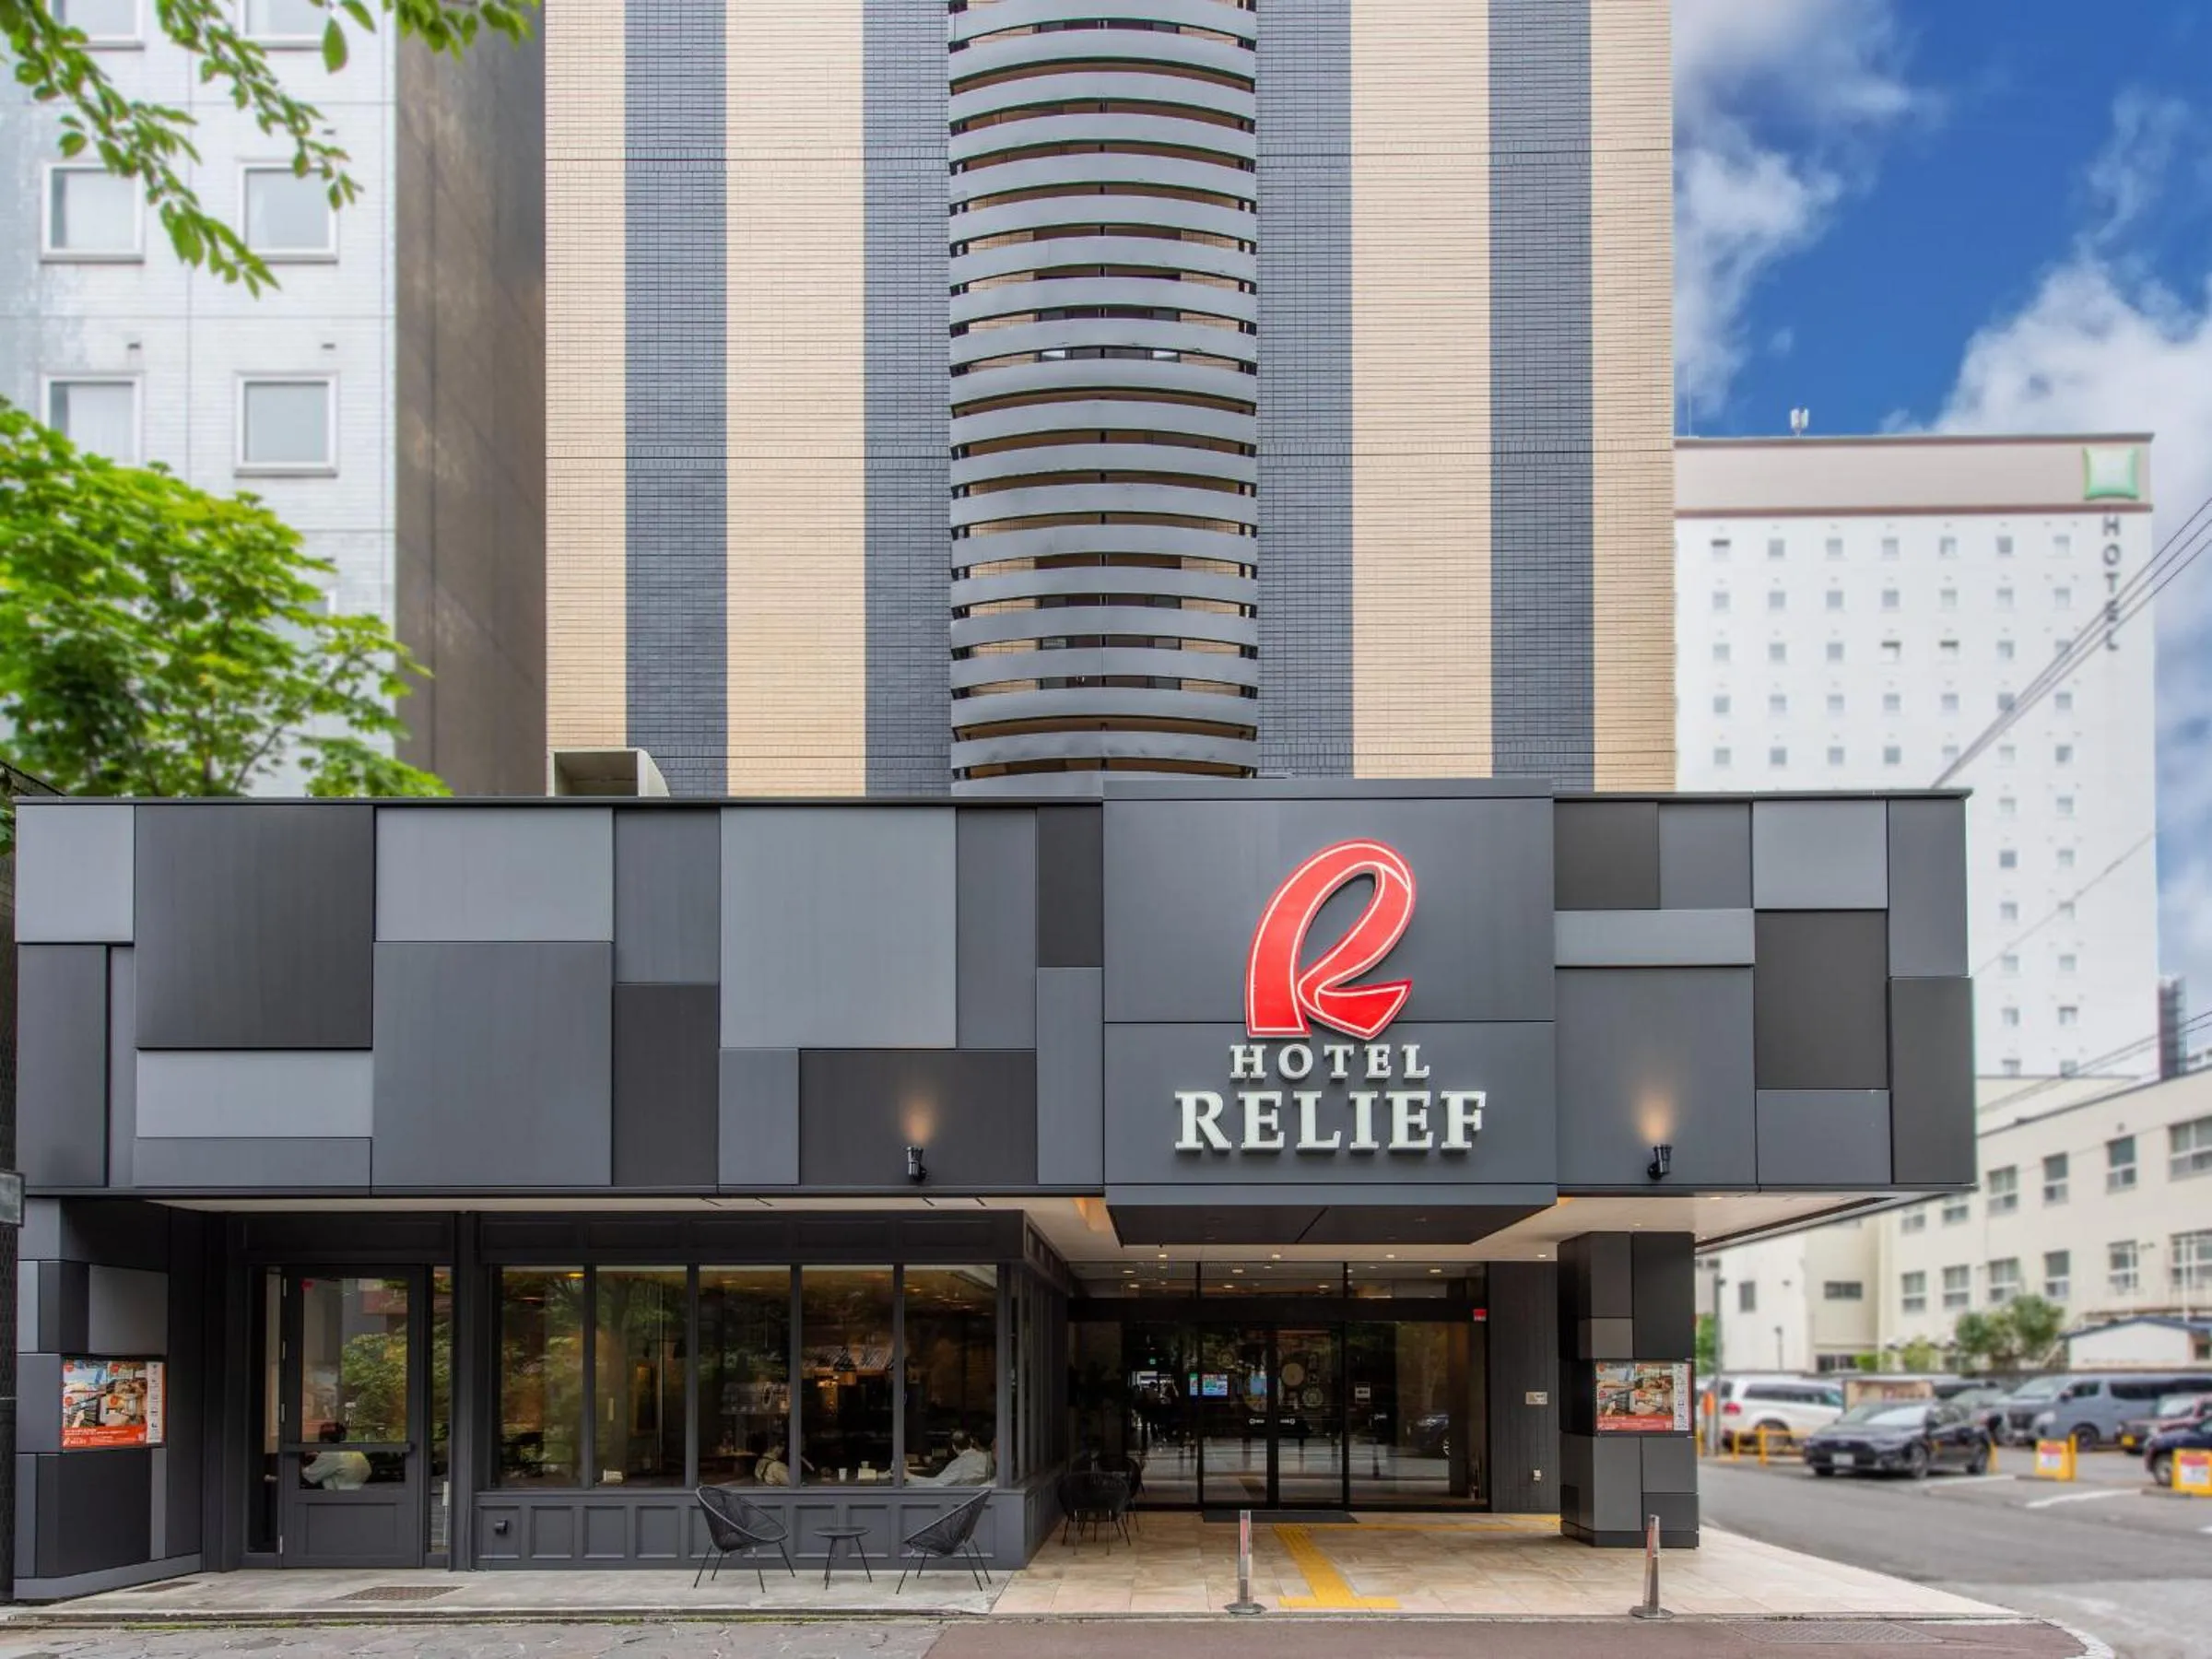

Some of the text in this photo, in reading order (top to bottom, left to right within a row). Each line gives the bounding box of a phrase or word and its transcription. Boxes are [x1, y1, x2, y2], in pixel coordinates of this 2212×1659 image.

[2102, 514, 2121, 651] HOTEL
[1229, 1043, 1430, 1080] HOTEL
[1174, 1090, 1487, 1150] RELIEF
